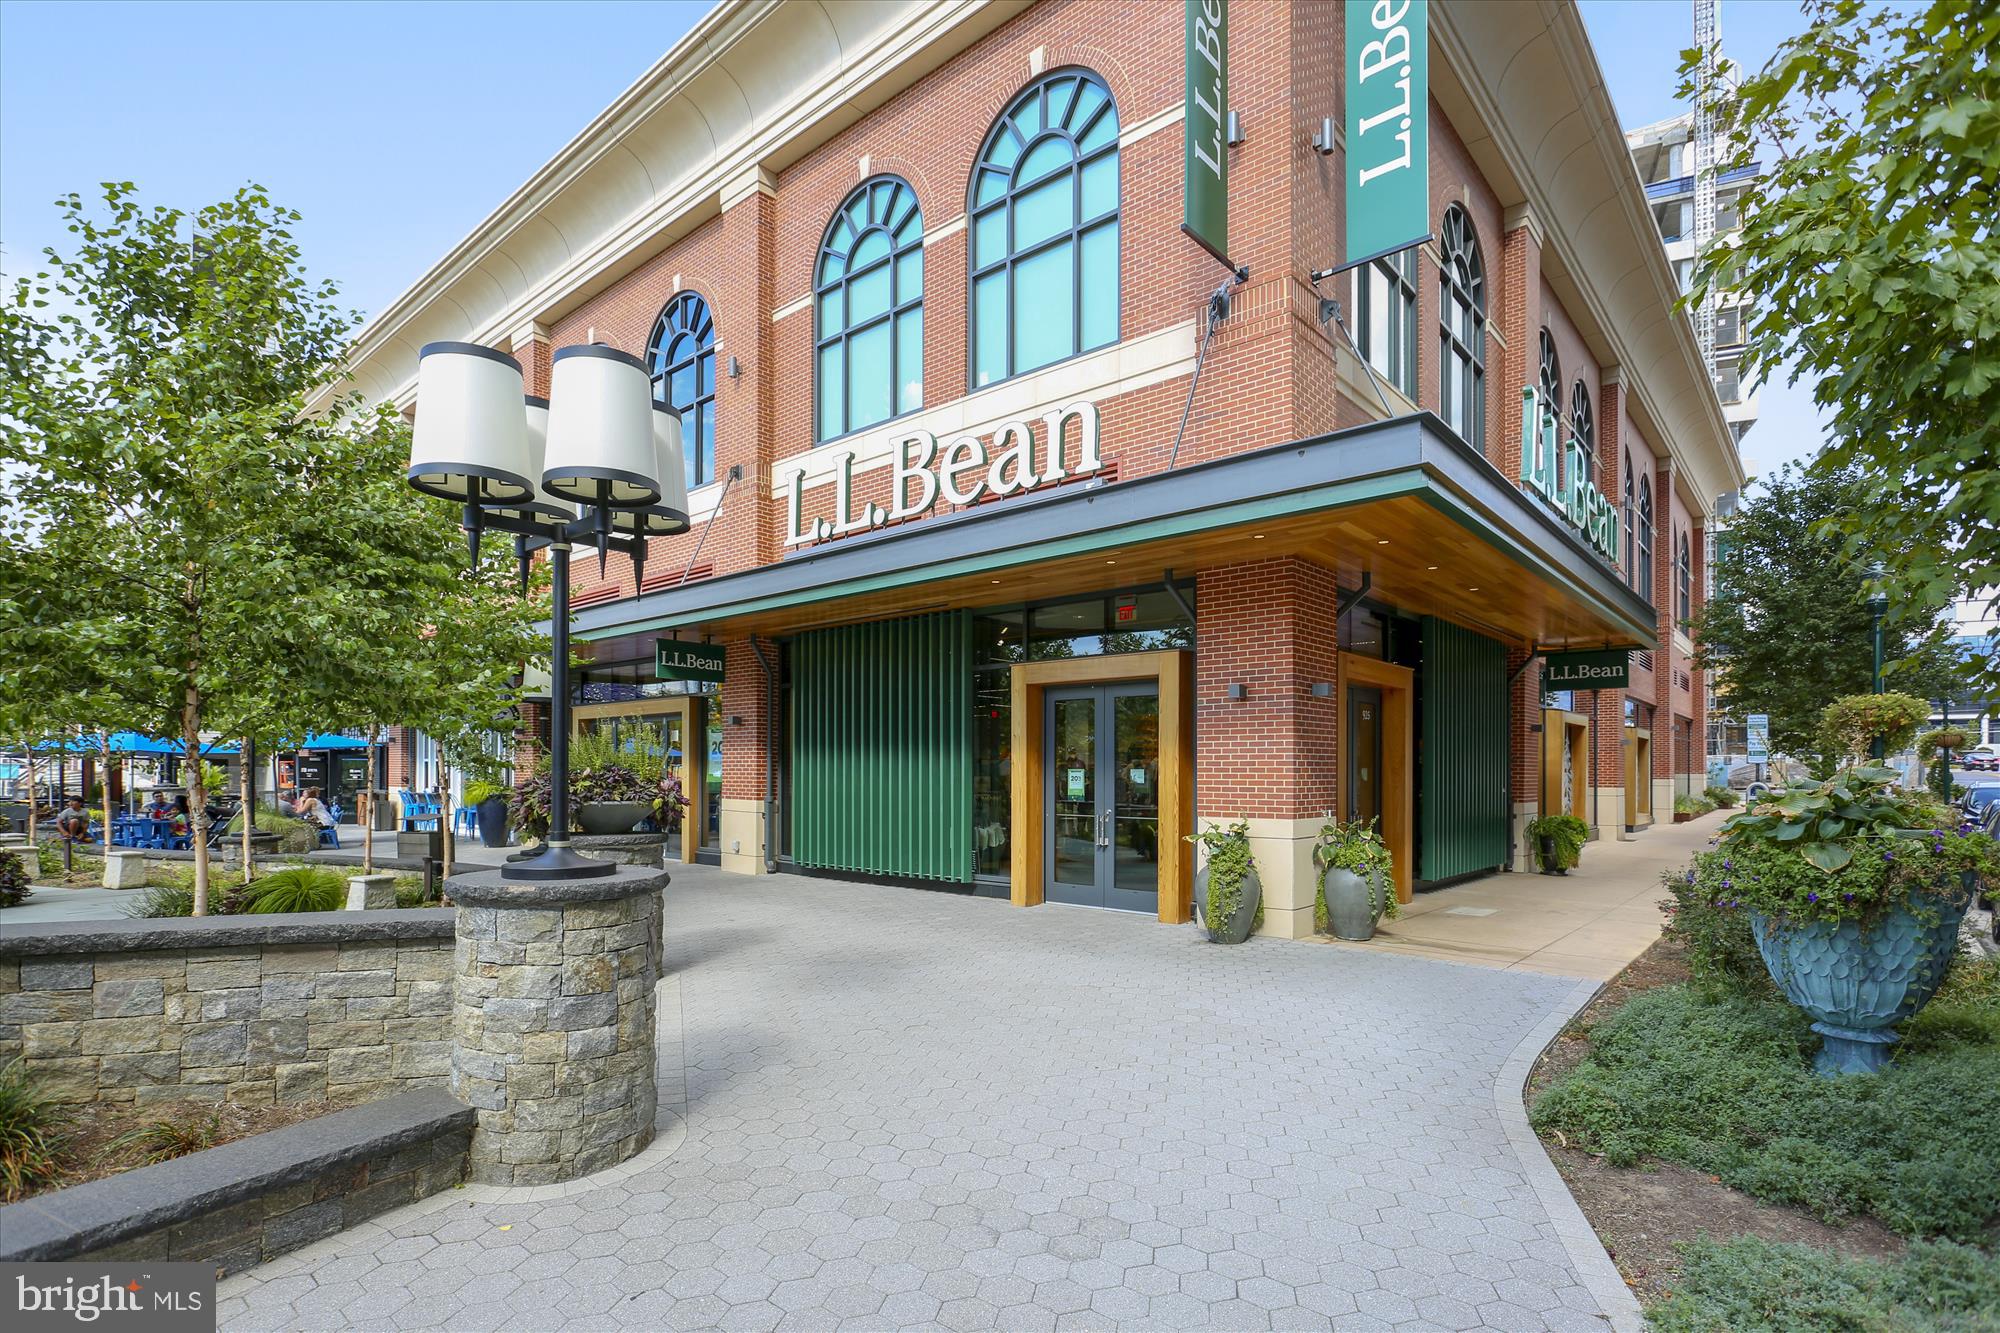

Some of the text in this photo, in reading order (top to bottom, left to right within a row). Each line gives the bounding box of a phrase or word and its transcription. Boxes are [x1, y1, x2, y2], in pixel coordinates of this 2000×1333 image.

[784, 401, 1105, 546] L.L.Bean
[1521, 384, 1619, 564] L.L.Bean
[661, 651, 722, 671] L.L.Bean
[1549, 664, 1624, 680] L.L.Bean
